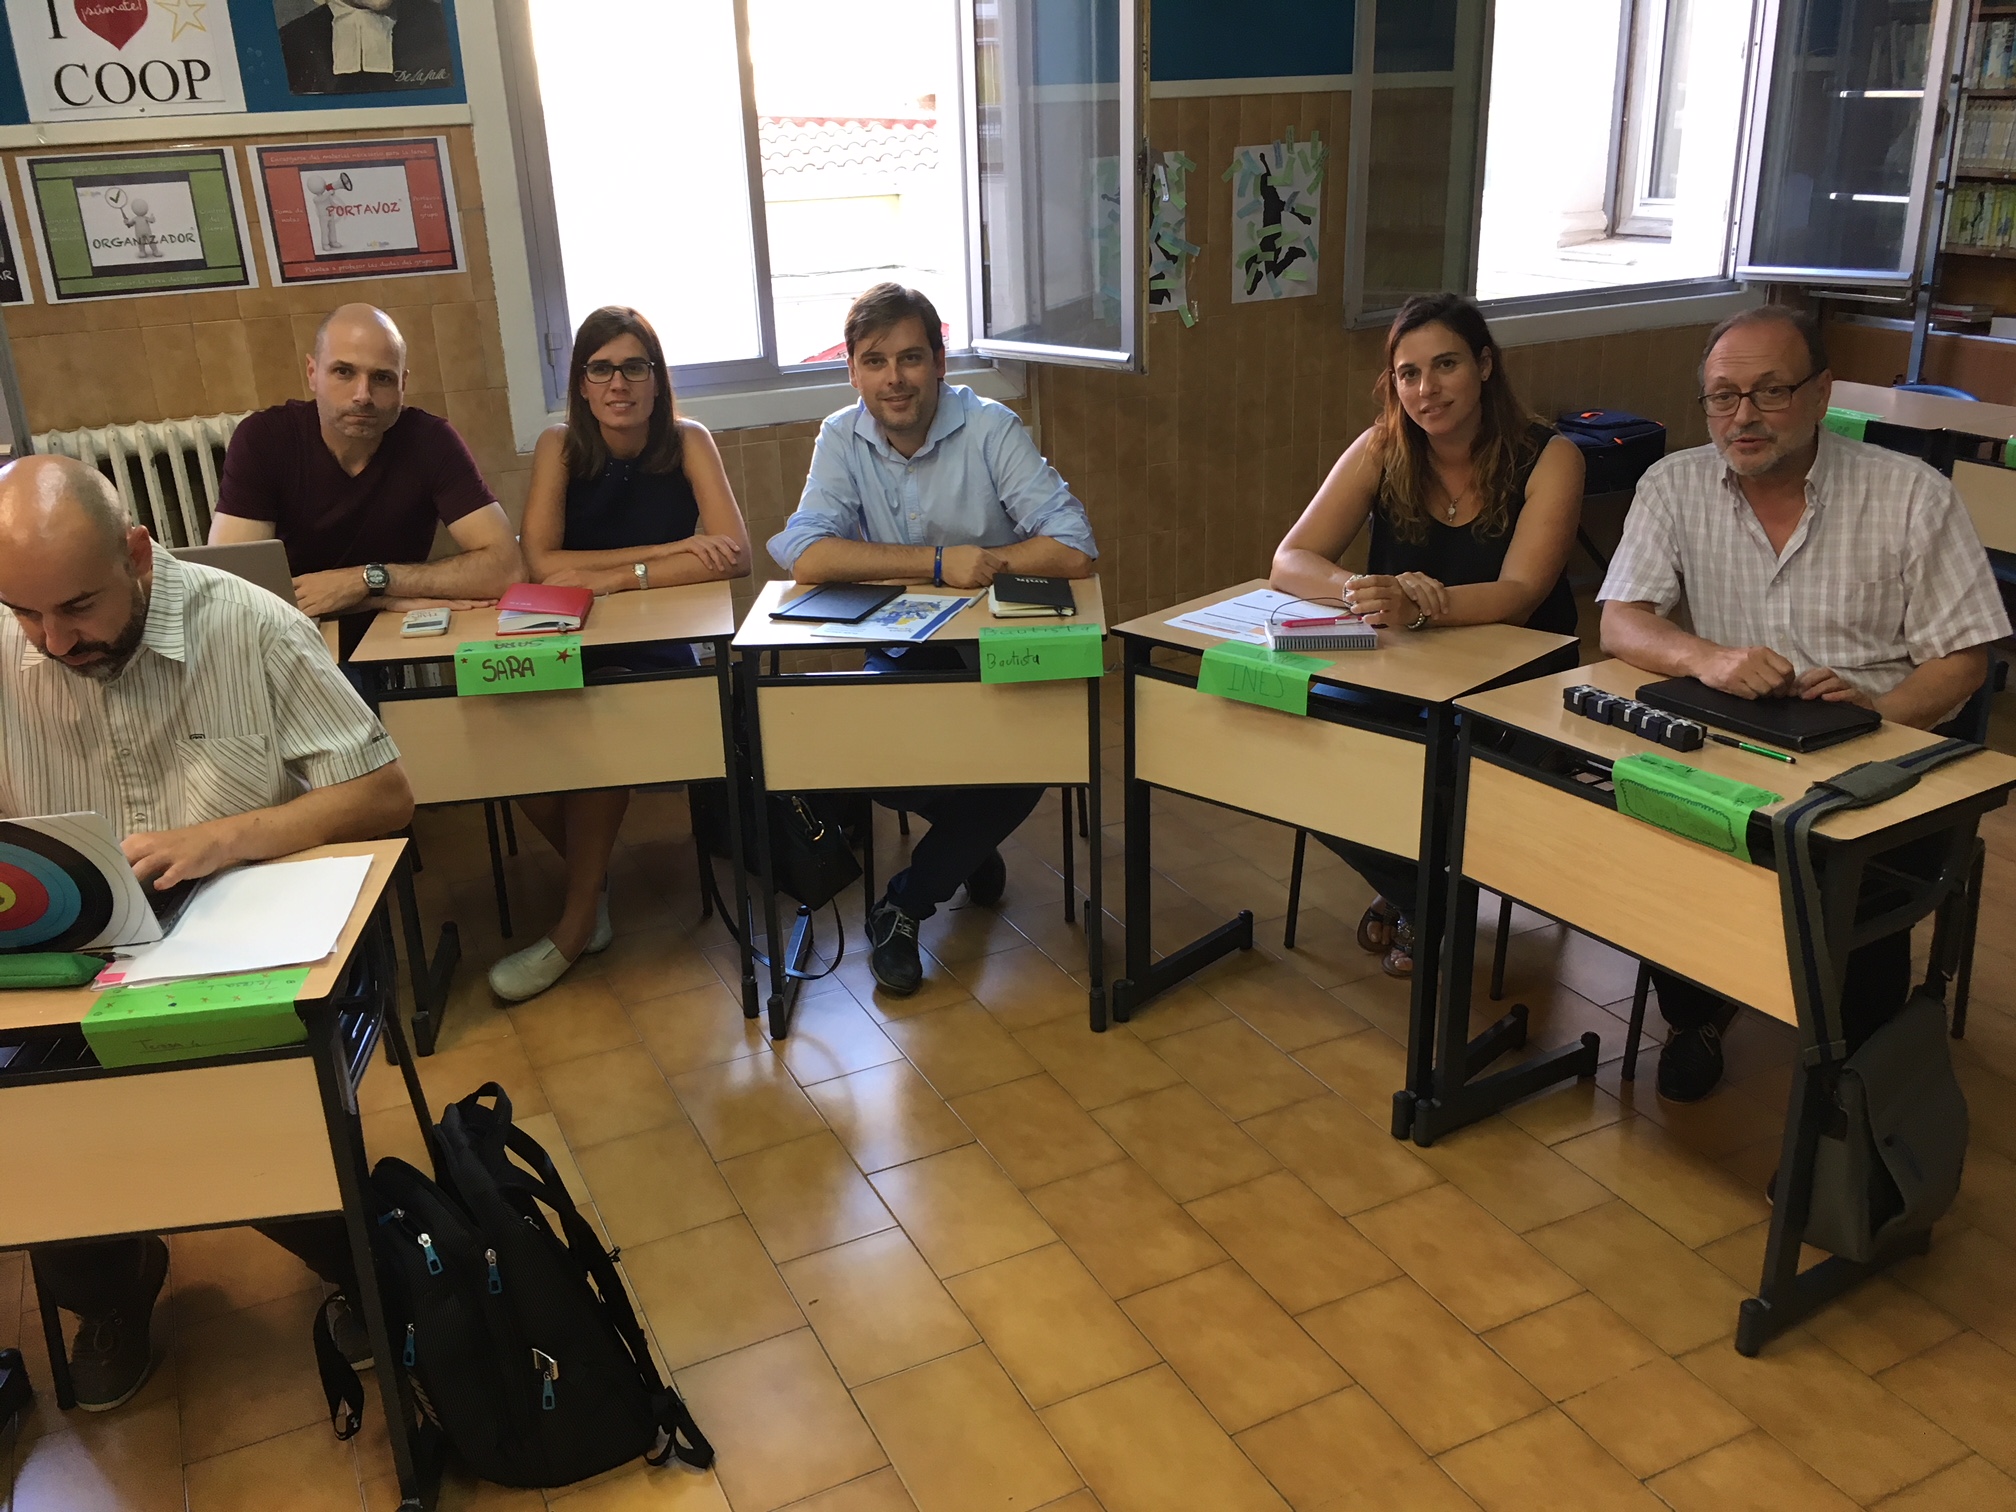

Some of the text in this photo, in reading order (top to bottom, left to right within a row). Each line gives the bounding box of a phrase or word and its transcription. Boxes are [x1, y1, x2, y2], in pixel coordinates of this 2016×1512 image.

[54, 58, 211, 107] COOP
[325, 202, 401, 218] PORTAVOZ
[92, 232, 196, 250] ORGANIZADOR
[494, 637, 546, 650] SARA
[482, 655, 536, 683] SARA
